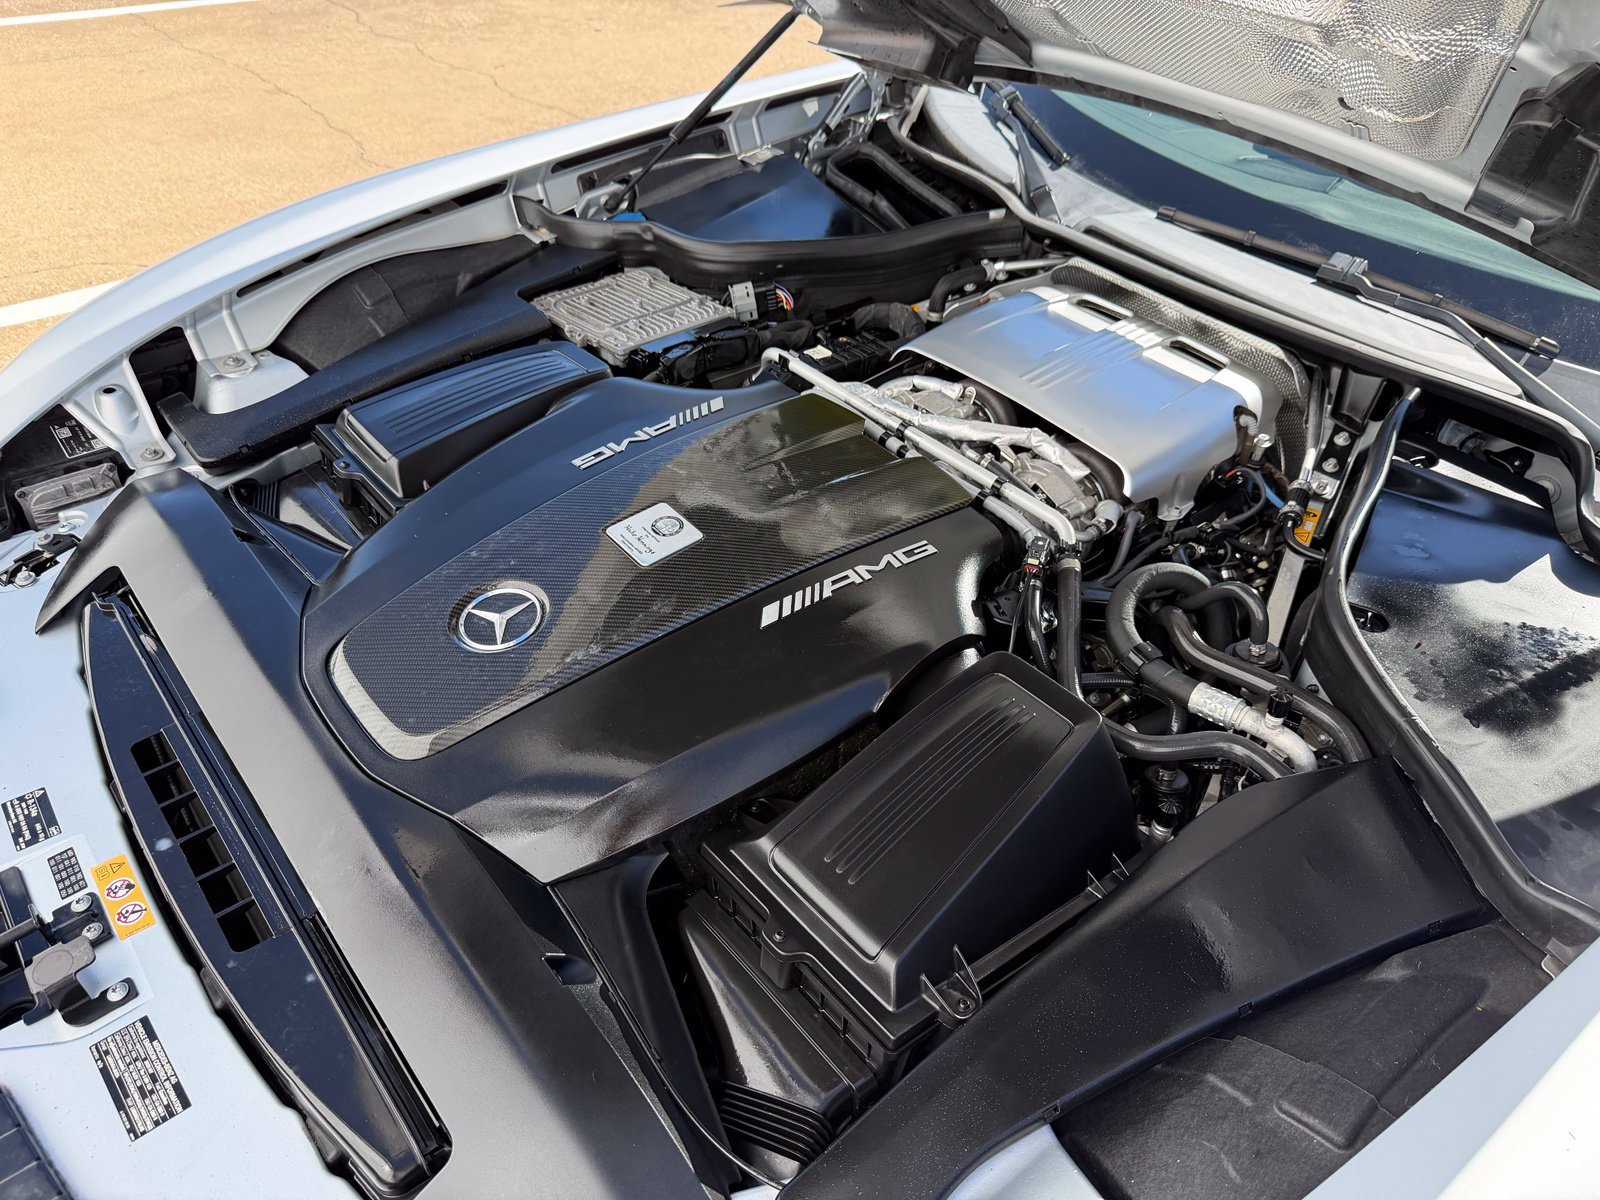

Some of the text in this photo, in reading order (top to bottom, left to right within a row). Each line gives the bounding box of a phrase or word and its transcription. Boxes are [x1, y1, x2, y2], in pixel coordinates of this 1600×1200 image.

[571, 415, 677, 470] AMG
[823, 540, 938, 600] AMG
[134, 1020, 147, 1040] VEHICLE
[142, 1038, 157, 1060] EMISSION
[152, 1058, 167, 1082] CONTROL
[163, 1080, 183, 1113] INFORMATION
